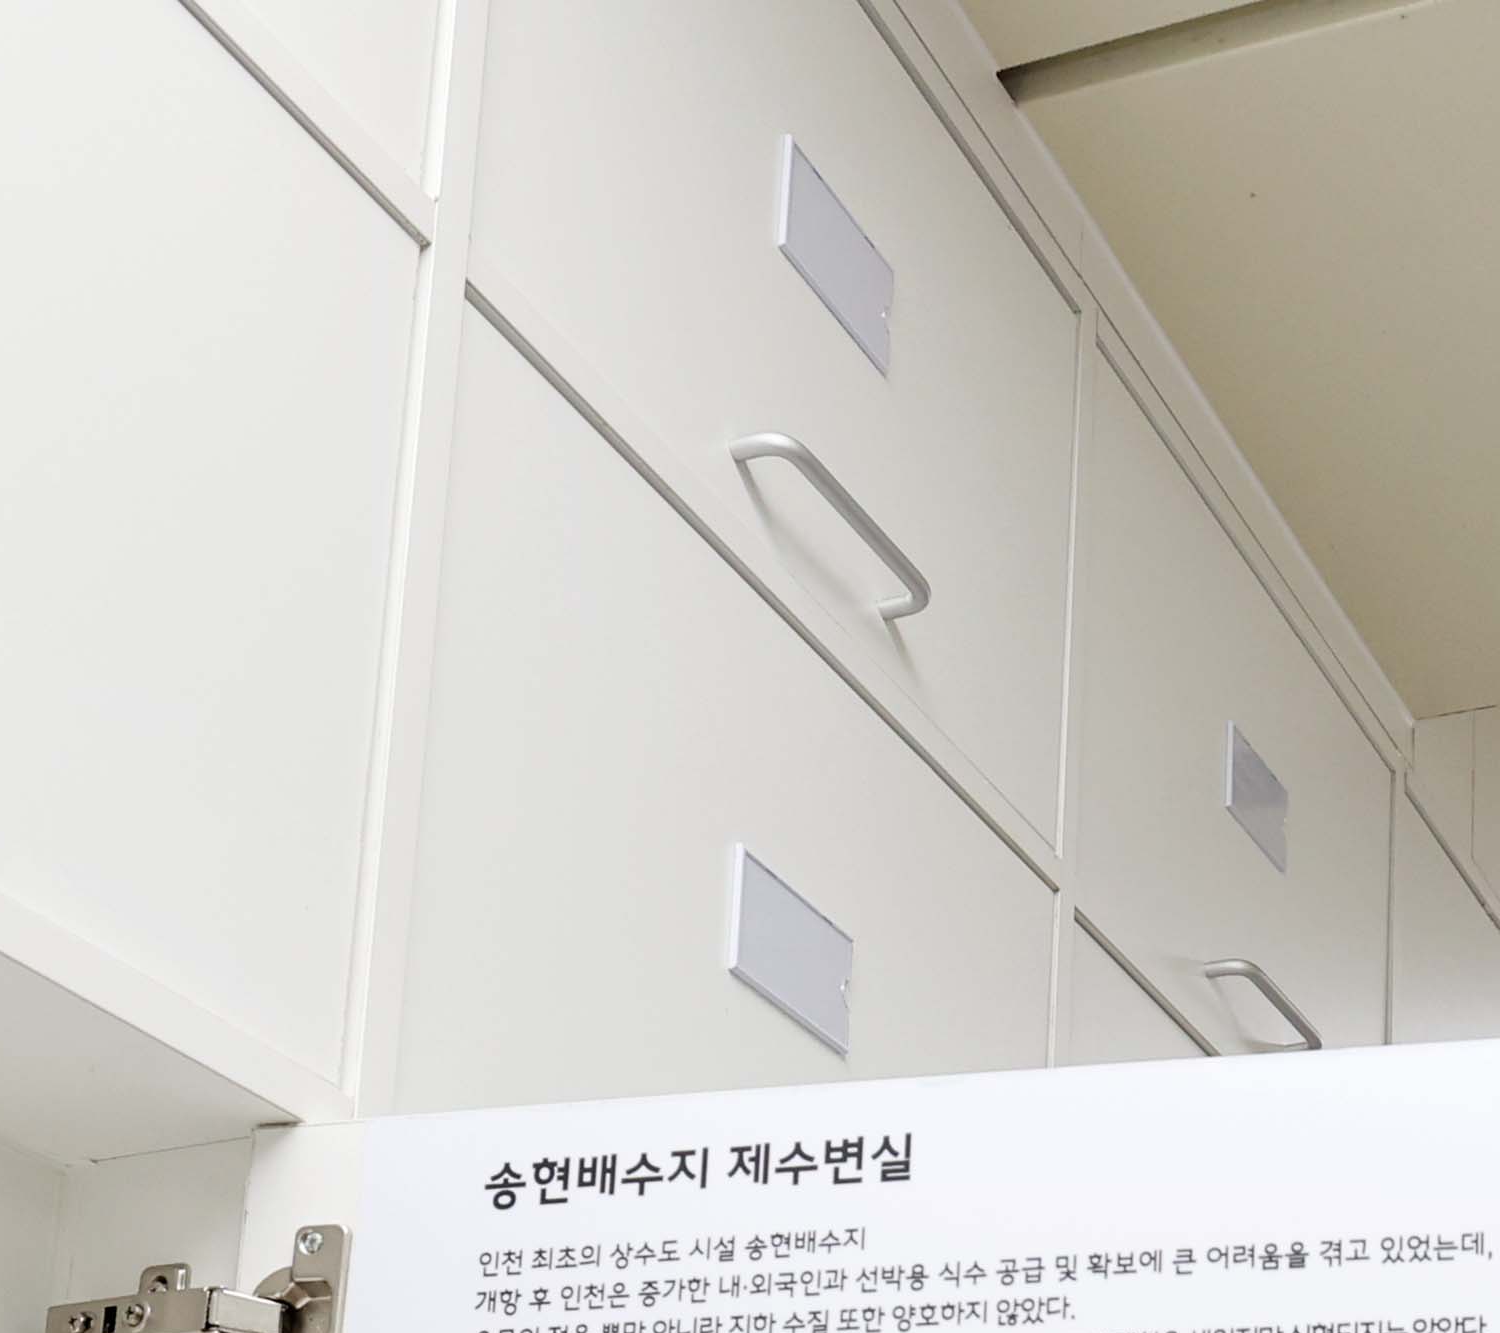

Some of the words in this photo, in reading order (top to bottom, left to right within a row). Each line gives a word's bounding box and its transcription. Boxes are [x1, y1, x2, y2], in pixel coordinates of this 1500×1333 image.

[483, 1145, 711, 1212] 송현배수지
[725, 1131, 913, 1187] 제수변실
[474, 1287, 523, 1318] 개항
[527, 1286, 553, 1313] 후
[559, 1281, 631, 1313] 인천은
[637, 1276, 712, 1309] 증가한
[854, 1262, 931, 1295] 선박용
[938, 1259, 988, 1289] 식수
[995, 1255, 1047, 1287] 공급
[1054, 1253, 1078, 1283] 및
[1085, 1248, 1163, 1280] 확보에
[1171, 1247, 1198, 1277] 큰
[1205, 1240, 1311, 1272] 어려움을
[1318, 1238, 1371, 1268] 겪고
[1379, 1230, 1494, 1265] 있었는데,
[478, 1248, 525, 1279] 인천
[530, 1244, 603, 1271] 최초의
[608, 1239, 682, 1271] 상수도
[688, 1235, 737, 1264] 시설
[743, 1226, 867, 1263] 송현배수지
[891, 1300, 989, 1333] 양호하지
[995, 1295, 1076, 1328] 않았다.
